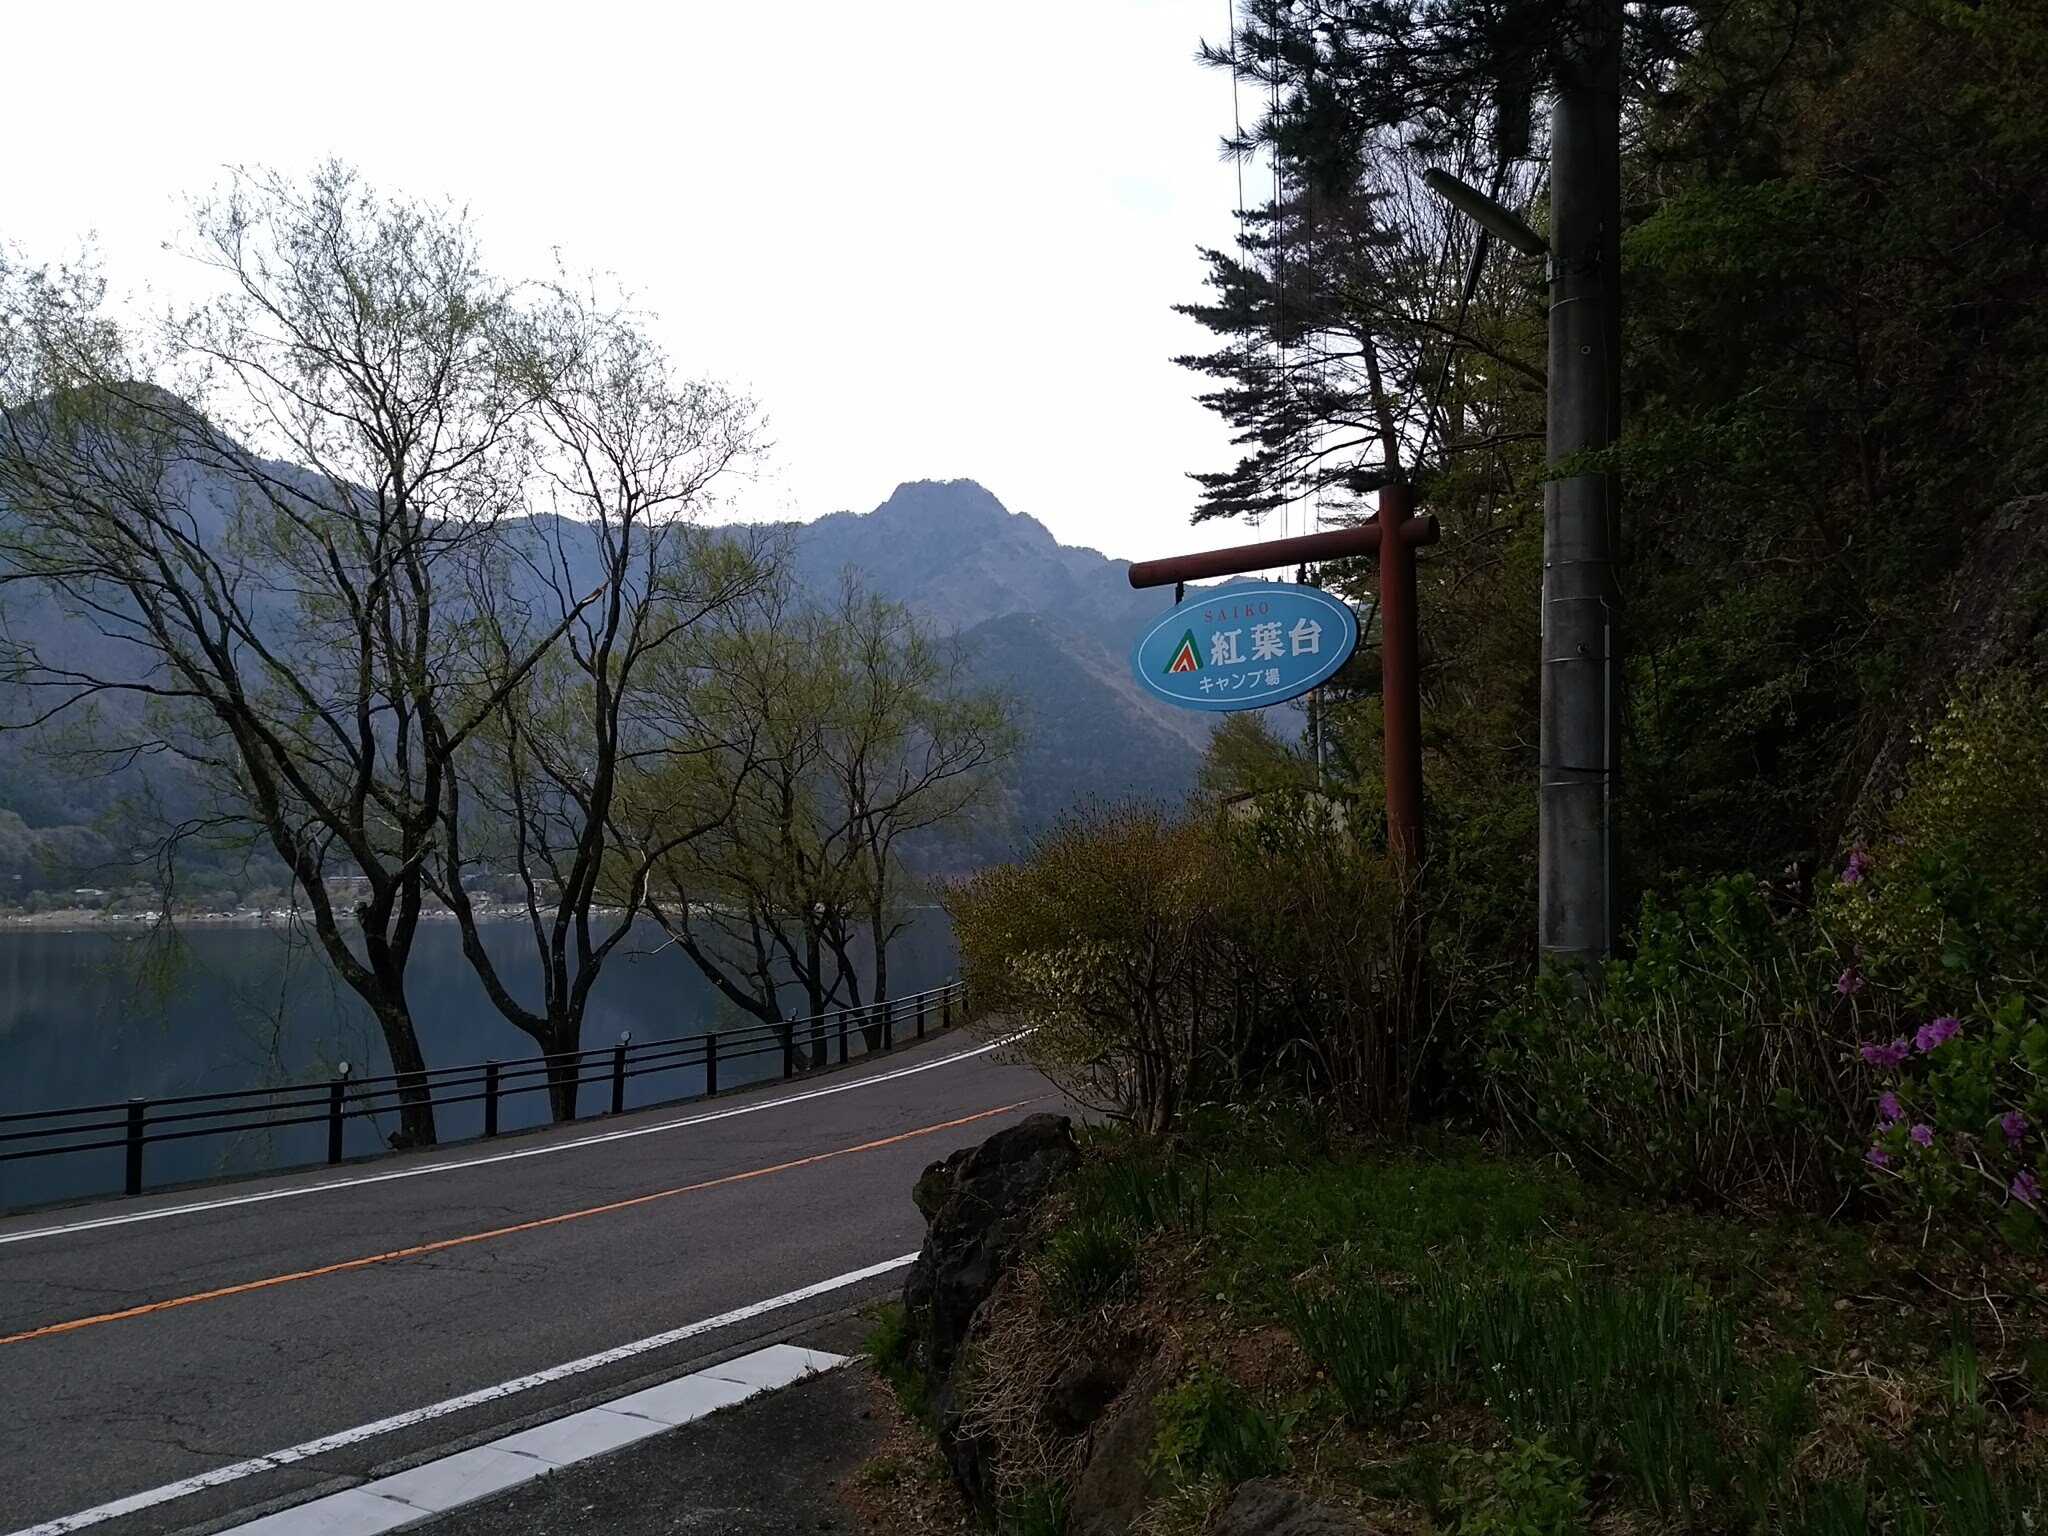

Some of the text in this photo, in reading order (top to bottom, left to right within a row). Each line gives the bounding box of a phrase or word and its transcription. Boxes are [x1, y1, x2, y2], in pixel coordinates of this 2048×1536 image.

[1204, 602, 1269, 623] SAIKO
[1210, 618, 1322, 666] 紅葉台
[1199, 668, 1281, 694] キャンプ場
